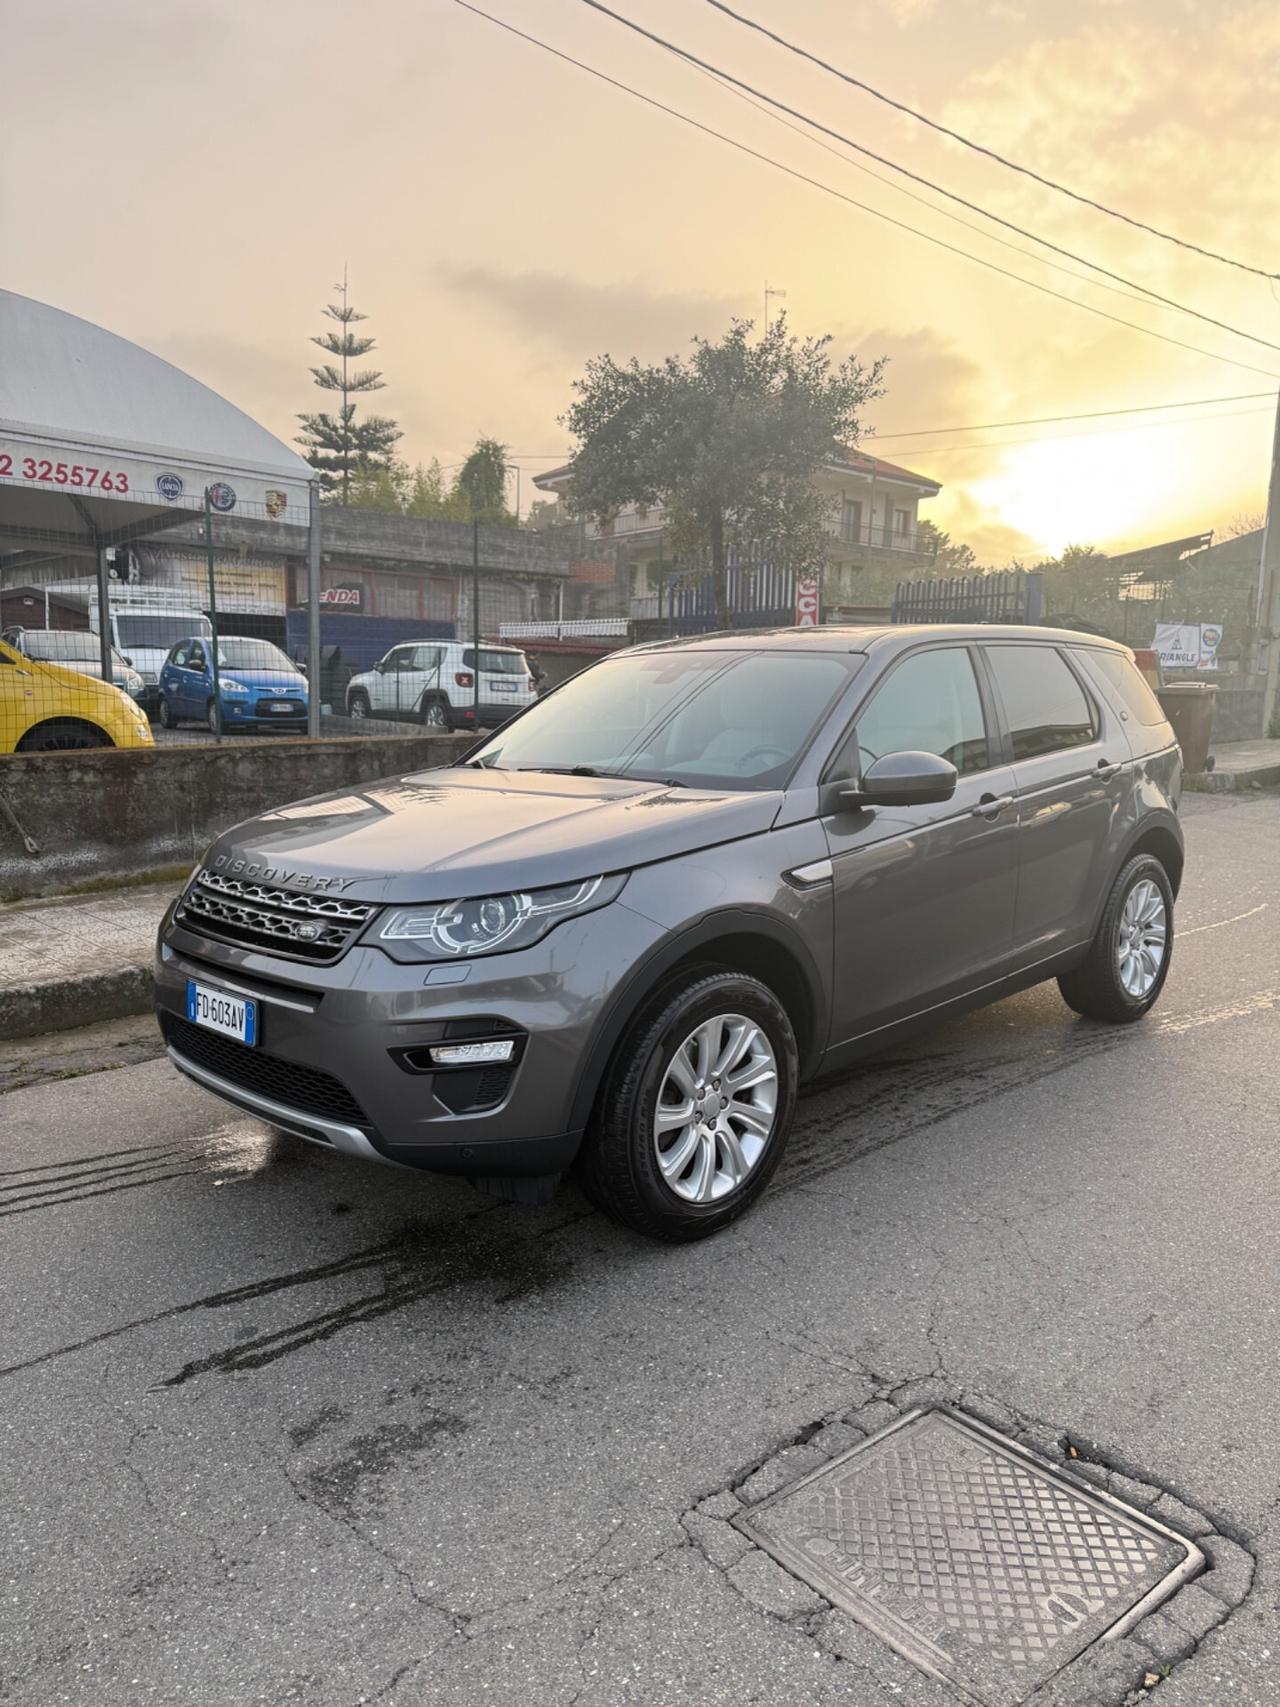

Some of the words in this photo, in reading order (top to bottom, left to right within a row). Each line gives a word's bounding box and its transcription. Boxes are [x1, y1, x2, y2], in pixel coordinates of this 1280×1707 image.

[22, 457, 129, 494] 3255763
[1159, 652, 1197, 662] RIANGLE
[214, 854, 355, 893] DISCOVERY
